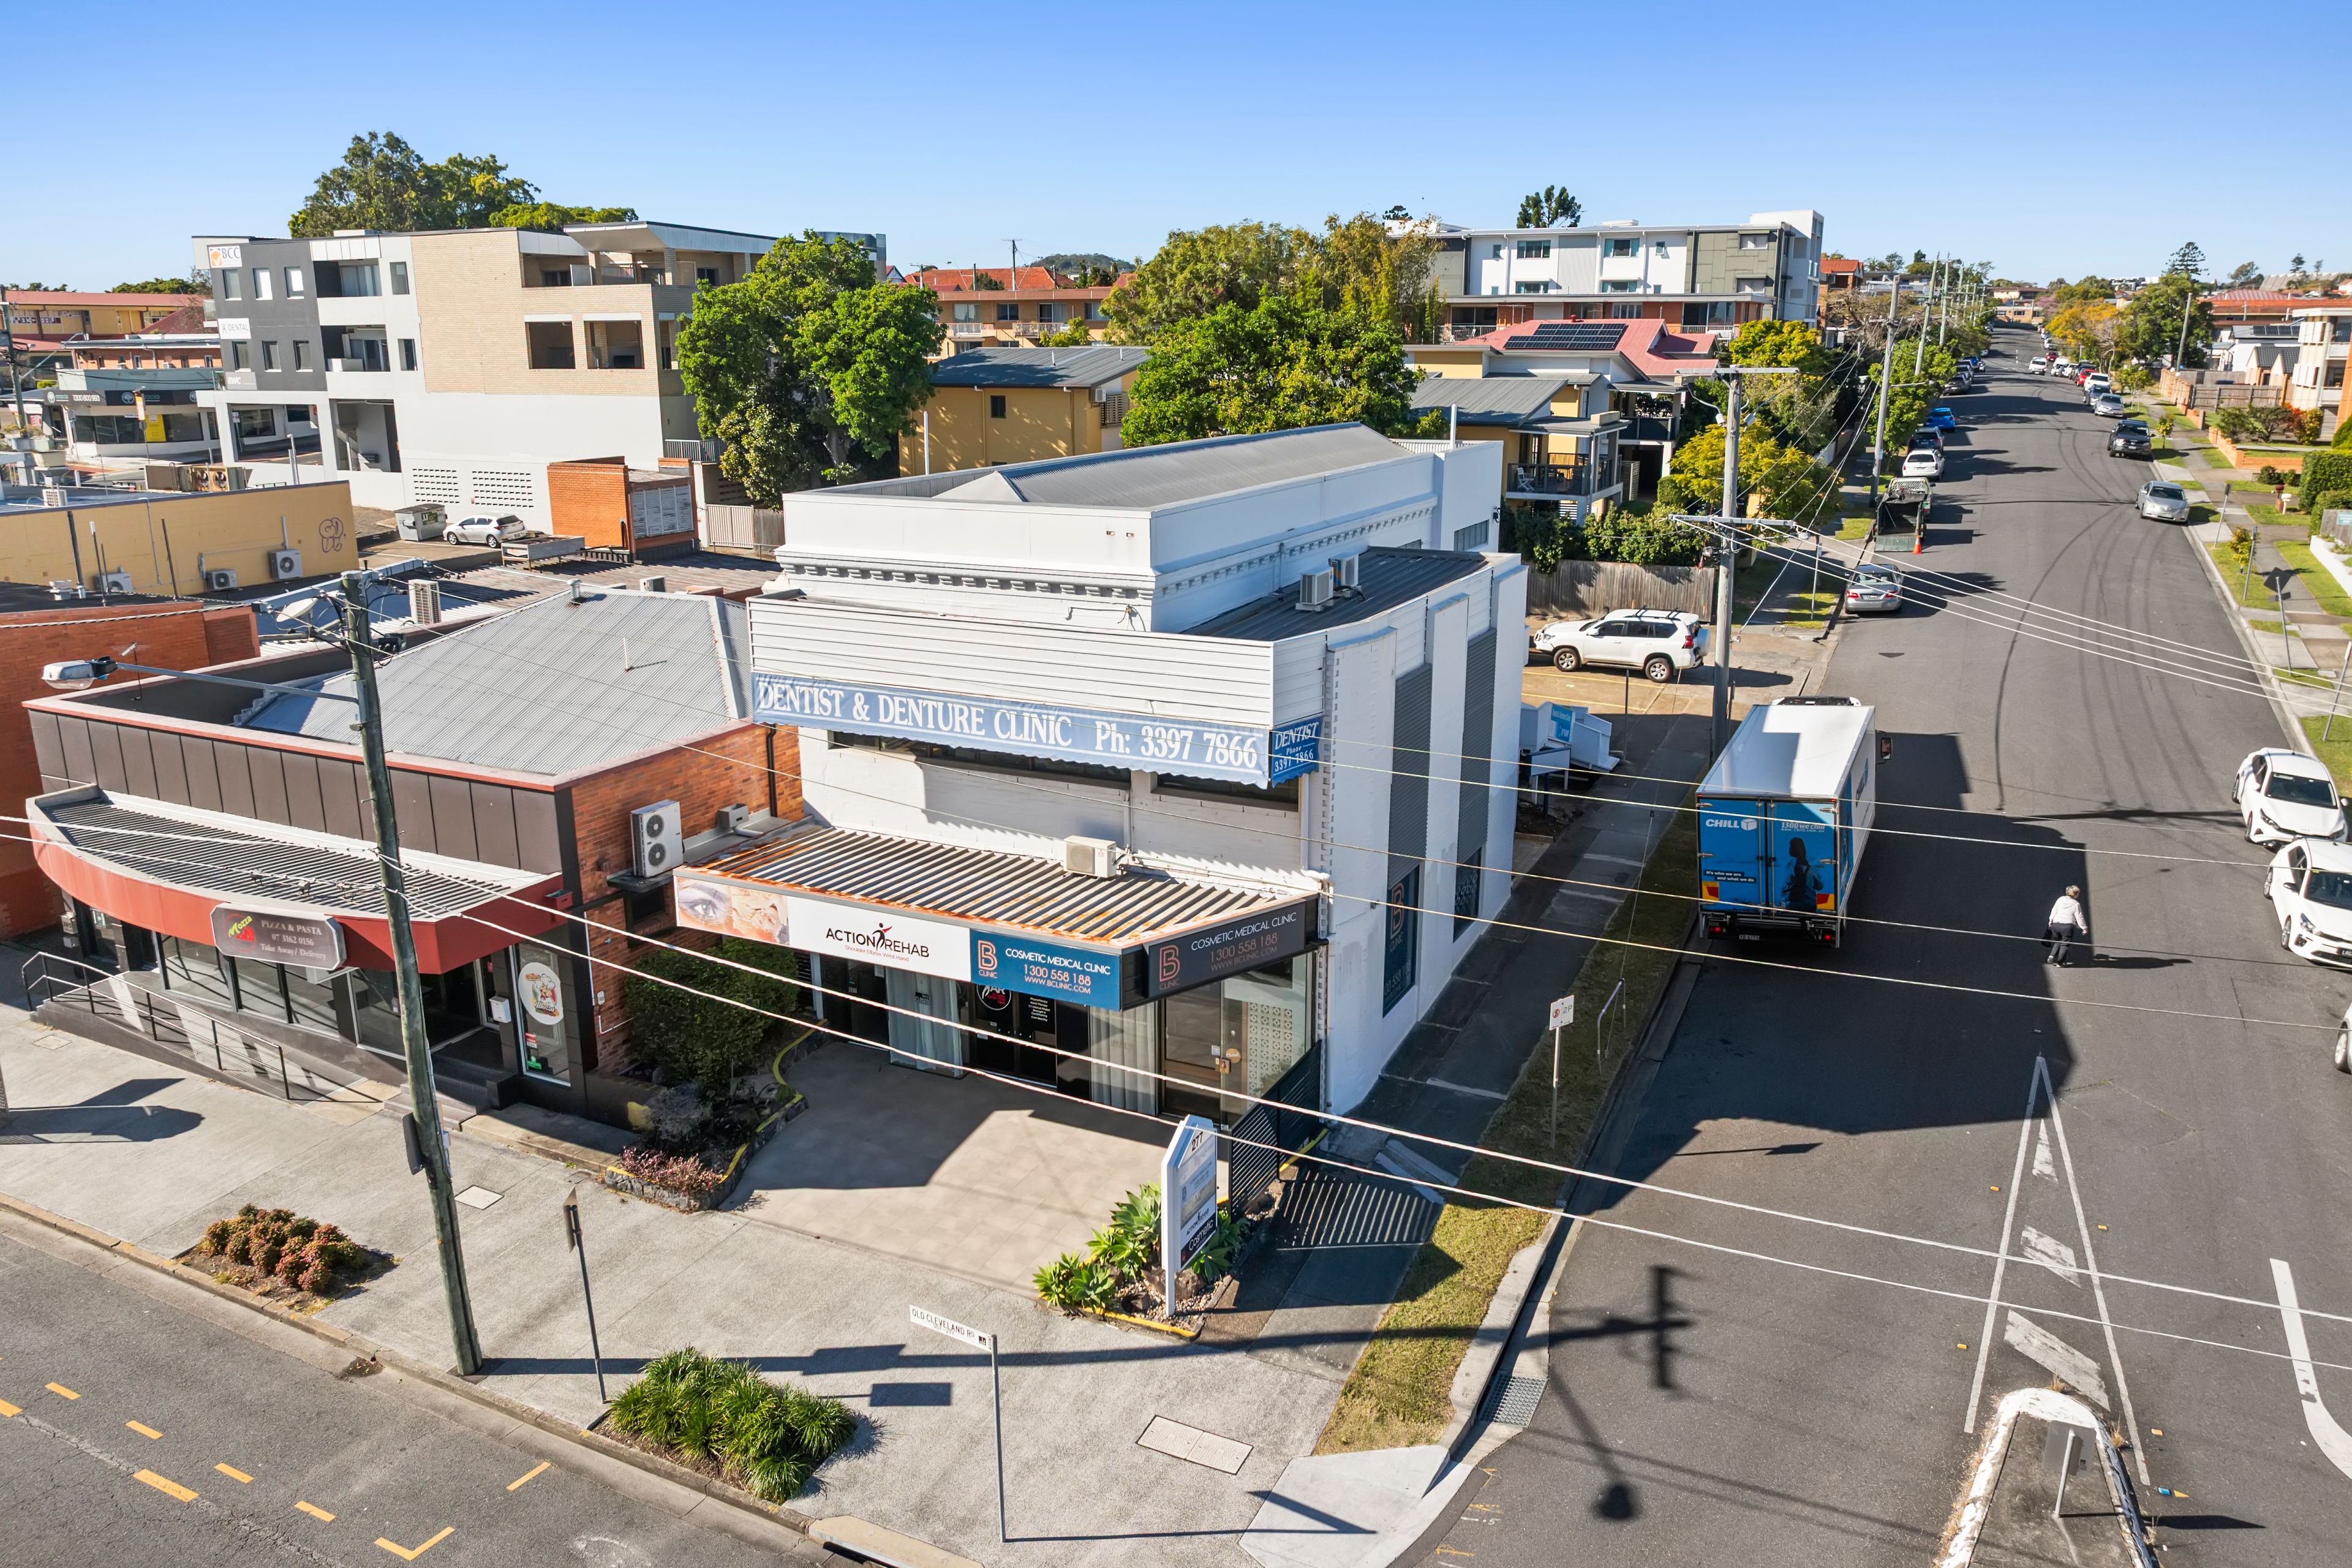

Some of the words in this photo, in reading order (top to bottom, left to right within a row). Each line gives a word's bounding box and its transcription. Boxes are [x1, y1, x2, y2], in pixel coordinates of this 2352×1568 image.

[222, 247, 240, 258] BCC
[758, 681, 844, 718] DENTIST
[853, 692, 870, 722] &
[878, 695, 986, 736] DENTURE
[993, 709, 1072, 747] CLINIC
[1095, 720, 1131, 755] Ph:
[1140, 725, 1194, 760] 3397
[1202, 733, 1257, 769] 7866
[1275, 722, 1319, 750] DENTIST
[1275, 756, 1292, 772] 3397
[1295, 748, 1314, 764] 7866
[1286, 745, 1302, 755] Phone
[1705, 818, 1740, 828] CHILL
[228, 916, 253, 938] Mozza
[261, 920, 287, 930] PIZZA
[296, 925, 323, 935] PASTA
[1191, 930, 1234, 951] COSMETIC
[1235, 921, 1270, 939] MEDICAL
[1272, 912, 1297, 927] CLINIC
[259, 943, 276, 952] Take
[300, 949, 326, 960] Delivery
[282, 935, 298, 944] 3162
[298, 937, 314, 946] 0156
[826, 927, 876, 948] ACTION
[884, 938, 930, 958] REHAB
[1210, 945, 1235, 963] 1300
[1237, 938, 1256, 954] 558
[1260, 932, 1278, 948] 188
[978, 940, 998, 971] B
[1005, 948, 1046, 963] COSMETIC
[1047, 955, 1082, 970] MEDICAL
[1084, 962, 1111, 975] CLINIC
[1159, 944, 1180, 982] B
[1210, 946, 1278, 971] WWW.BCLINIC.COM
[979, 970, 998, 979] CLINIC
[1023, 964, 1048, 979] 1300
[1050, 969, 1069, 982] 558
[1073, 973, 1091, 986] 188
[1024, 975, 1091, 995] WWW.BCLINIC.COM
[1159, 978, 1180, 990] CLINIC
[1562, 1005, 1573, 1014] 2P
[1191, 1131, 1204, 1152] 277
[1189, 1219, 1213, 1251] Cosmetic
[912, 1308, 925, 1319] OLD
[927, 1314, 965, 1335] CLEVELAND
